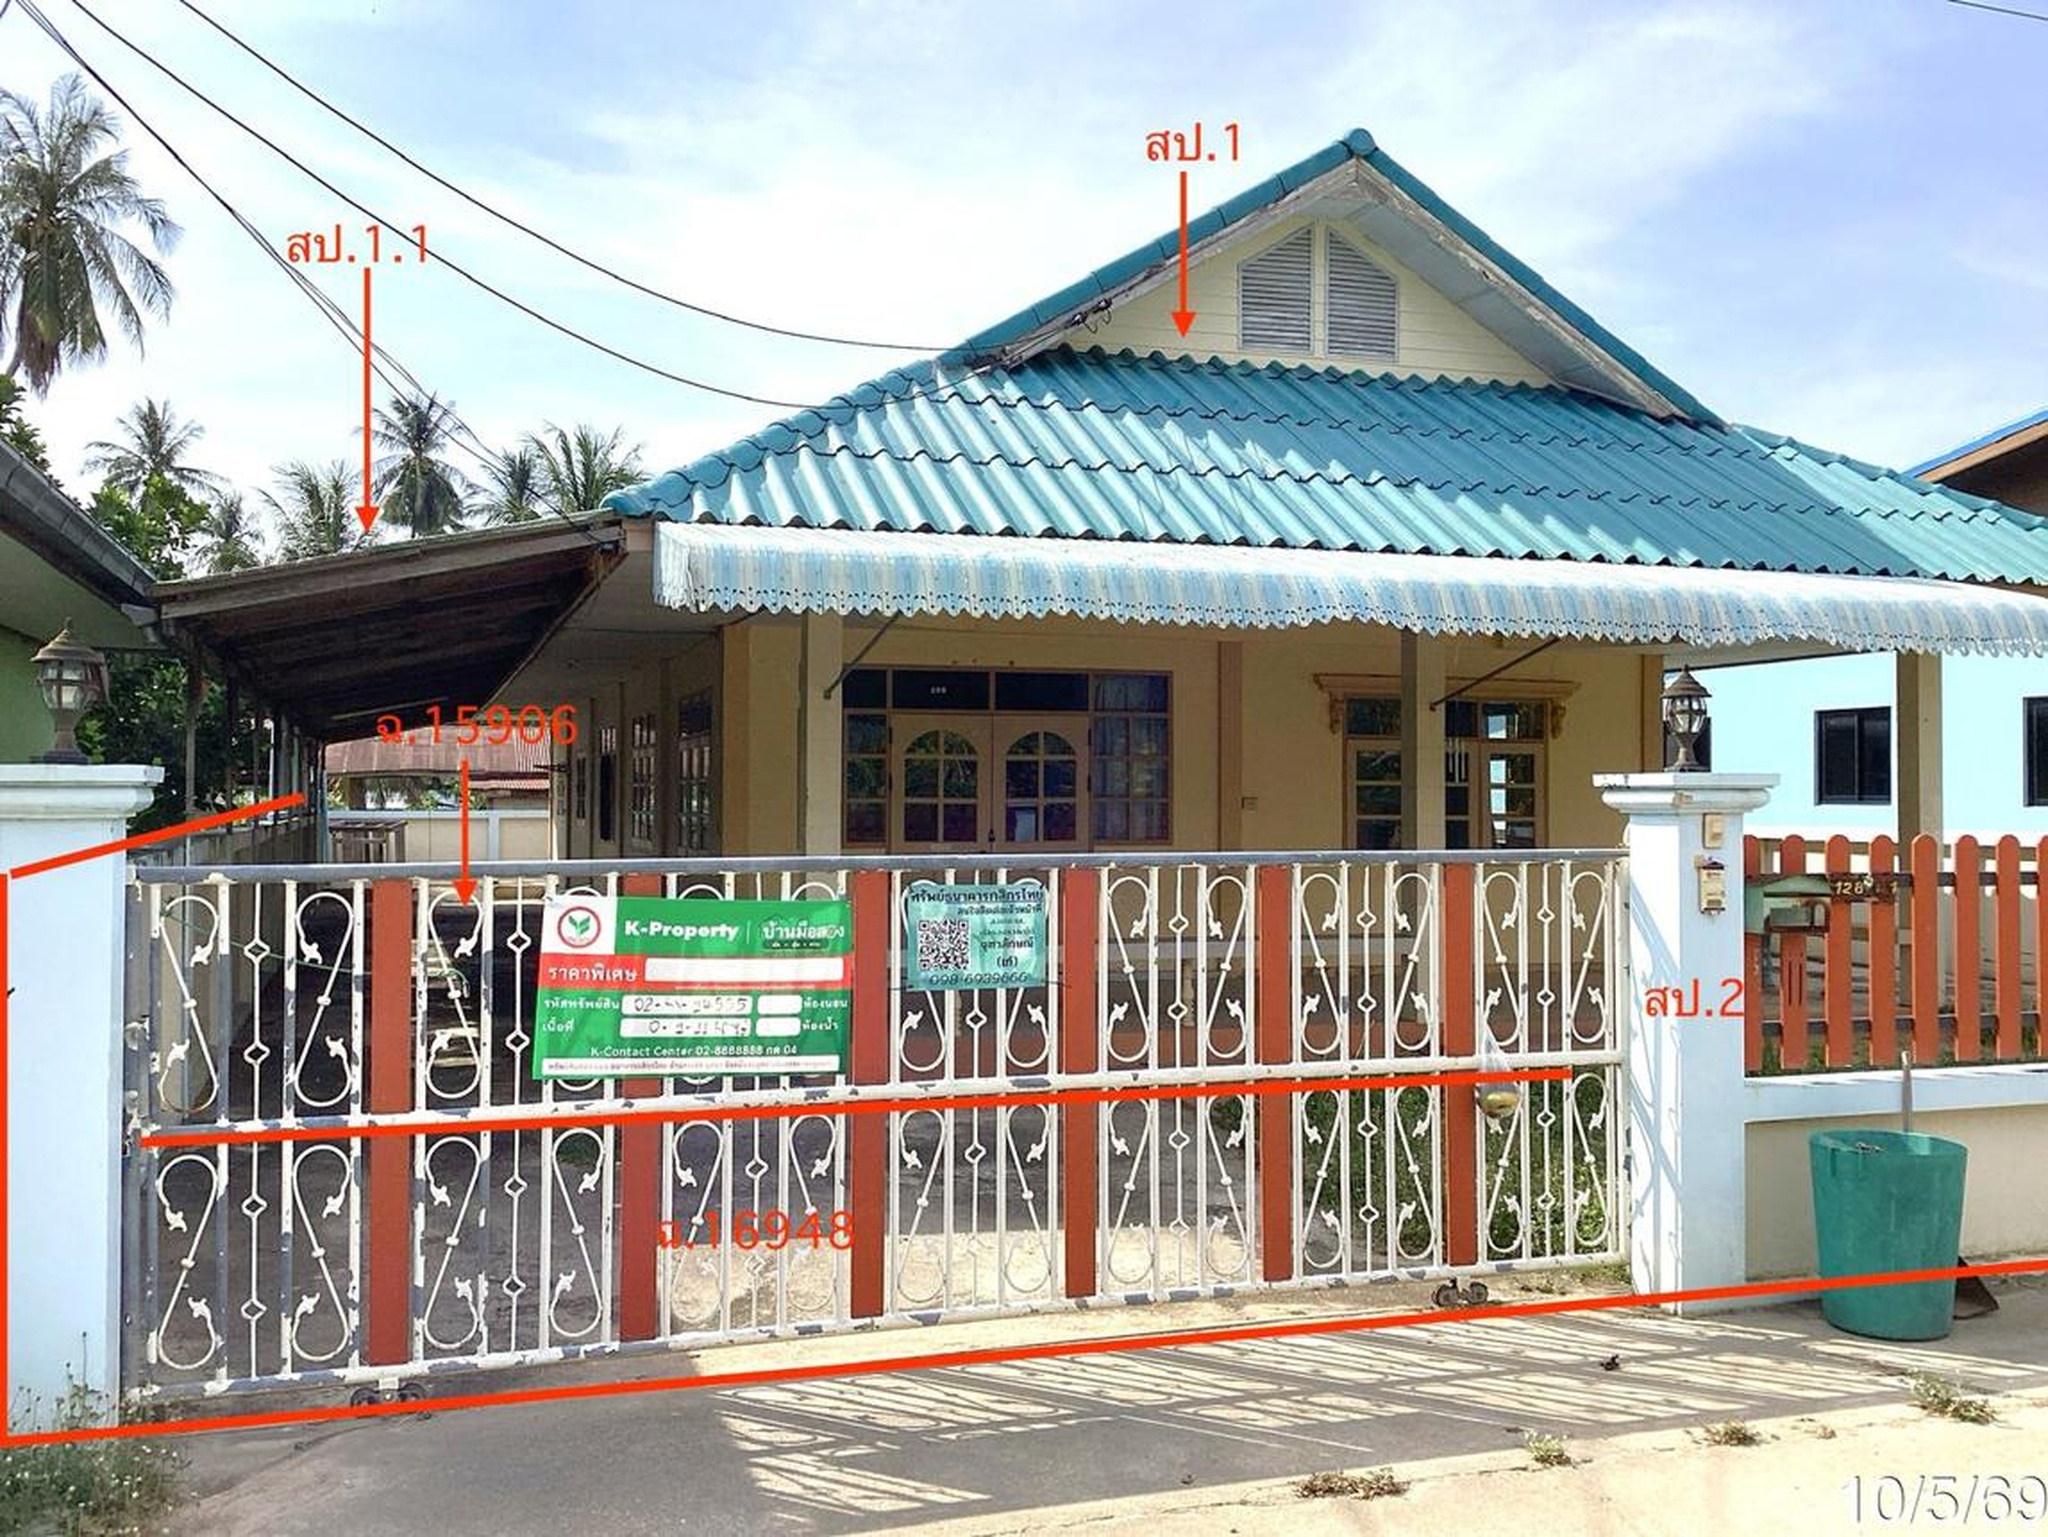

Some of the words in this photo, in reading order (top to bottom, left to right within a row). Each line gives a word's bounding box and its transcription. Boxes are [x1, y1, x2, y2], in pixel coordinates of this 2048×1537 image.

[624, 919, 739, 942] K-Property
[548, 962, 638, 982] ราคาพิเศษ
[654, 1046, 693, 1057] Center
[783, 1043, 798, 1055] 04
